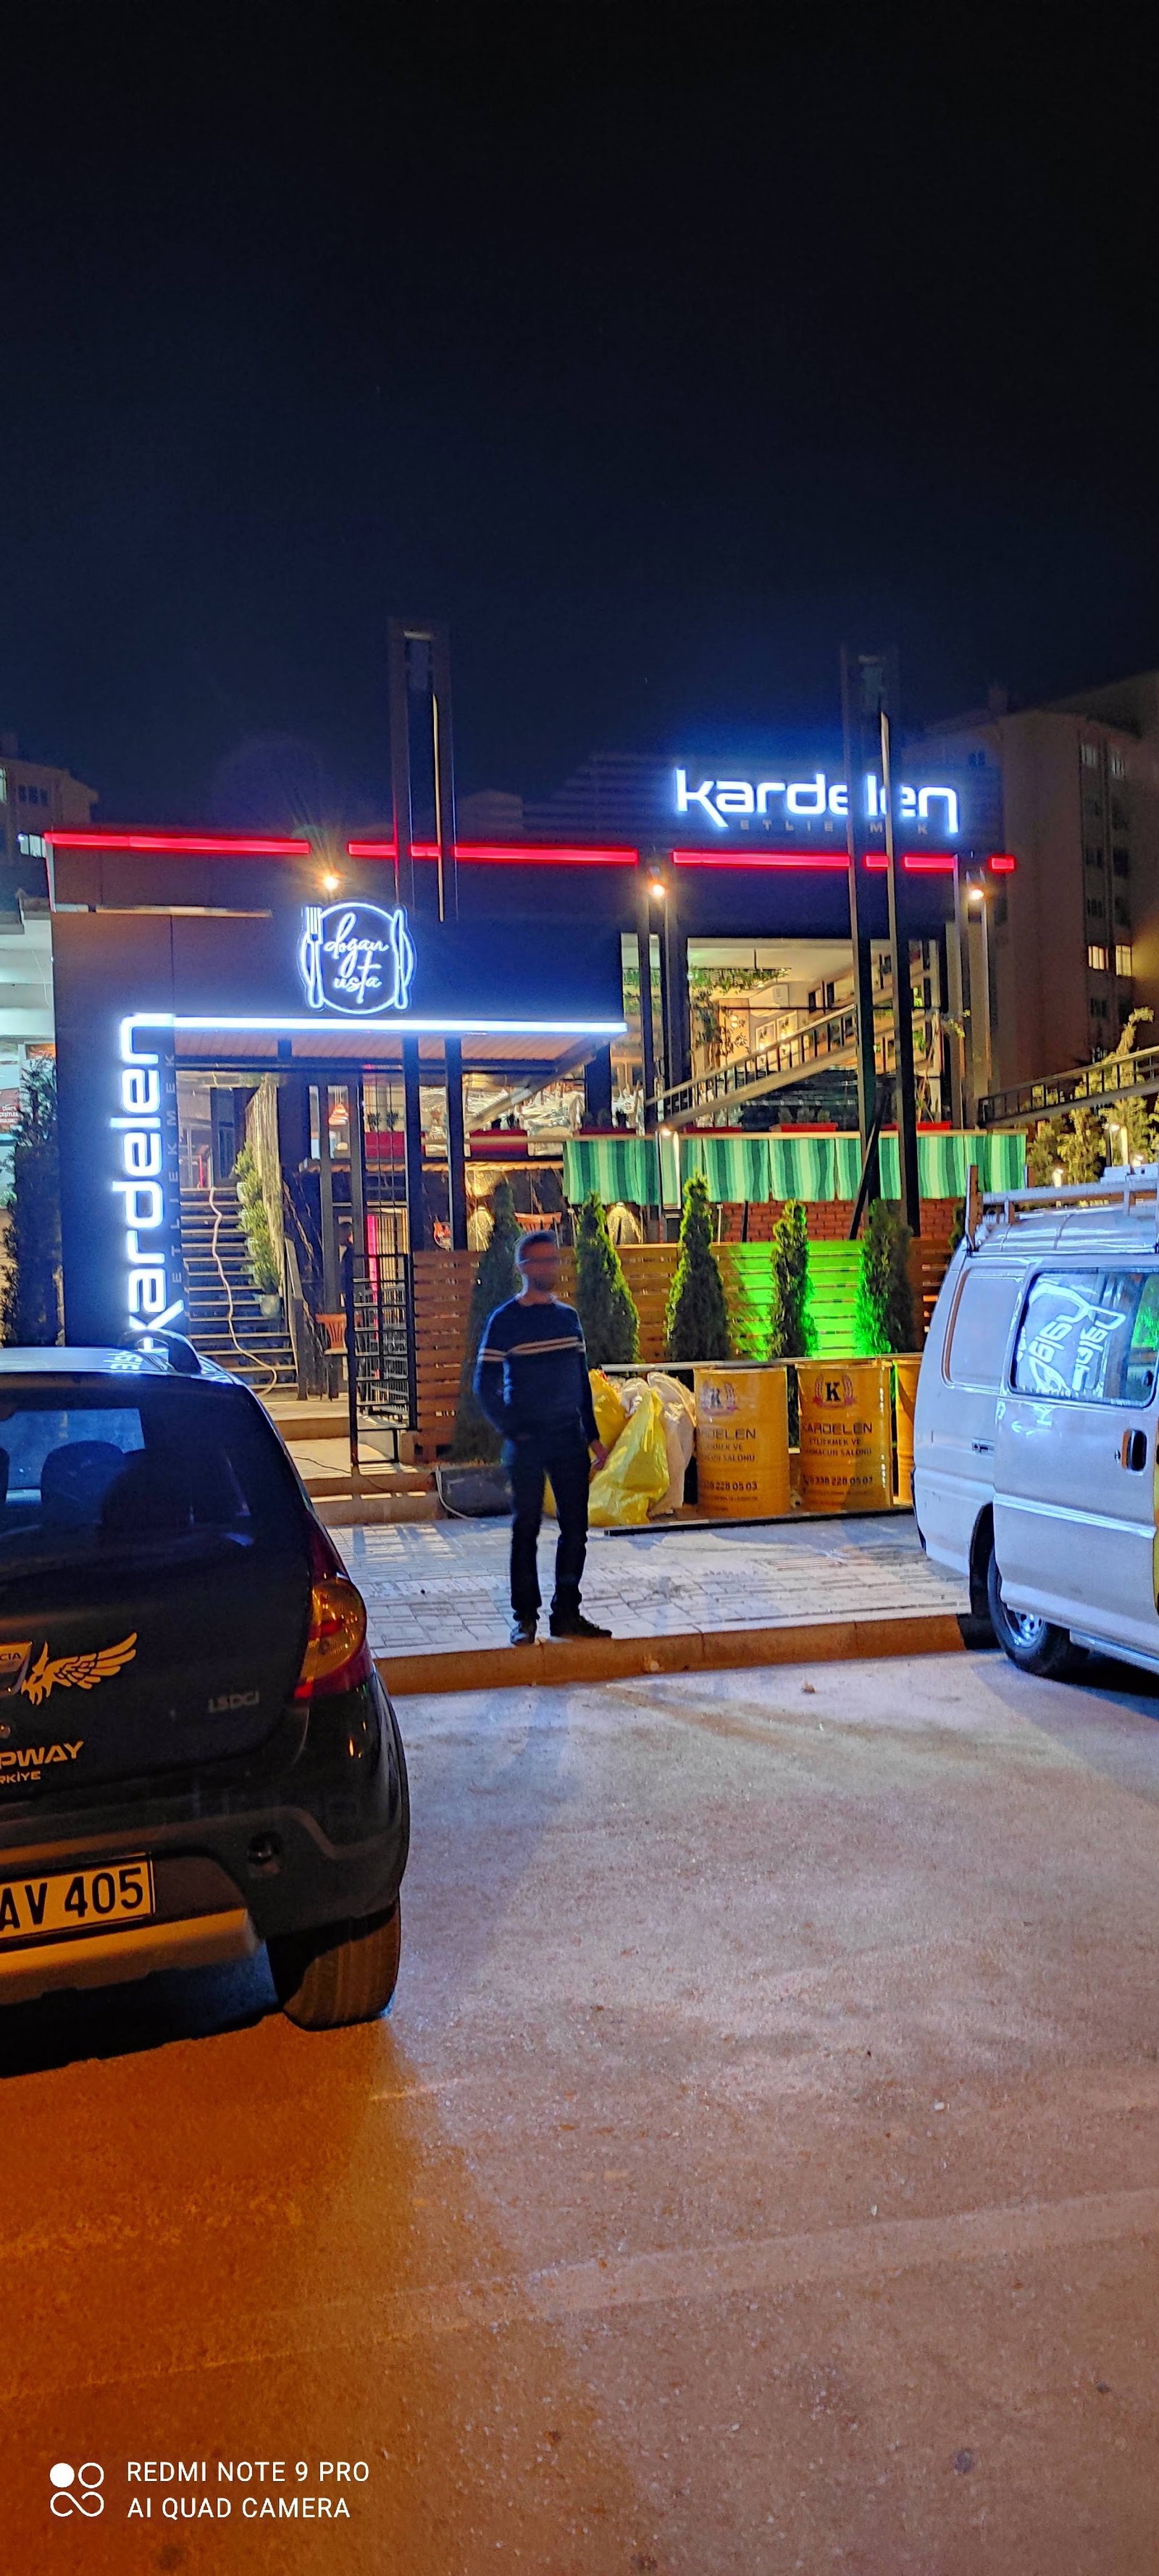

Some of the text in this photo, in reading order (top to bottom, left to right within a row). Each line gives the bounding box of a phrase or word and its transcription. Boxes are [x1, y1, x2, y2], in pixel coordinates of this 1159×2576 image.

[675, 769, 958, 832] kardelen
[333, 950, 382, 1004] usta
[111, 1013, 184, 1352] kardelen
[825, 1381, 841, 1402] K
[732, 1481, 745, 1491] 05
[745, 1481, 758, 1491] 03
[0, 1867, 143, 1931] AV 405
